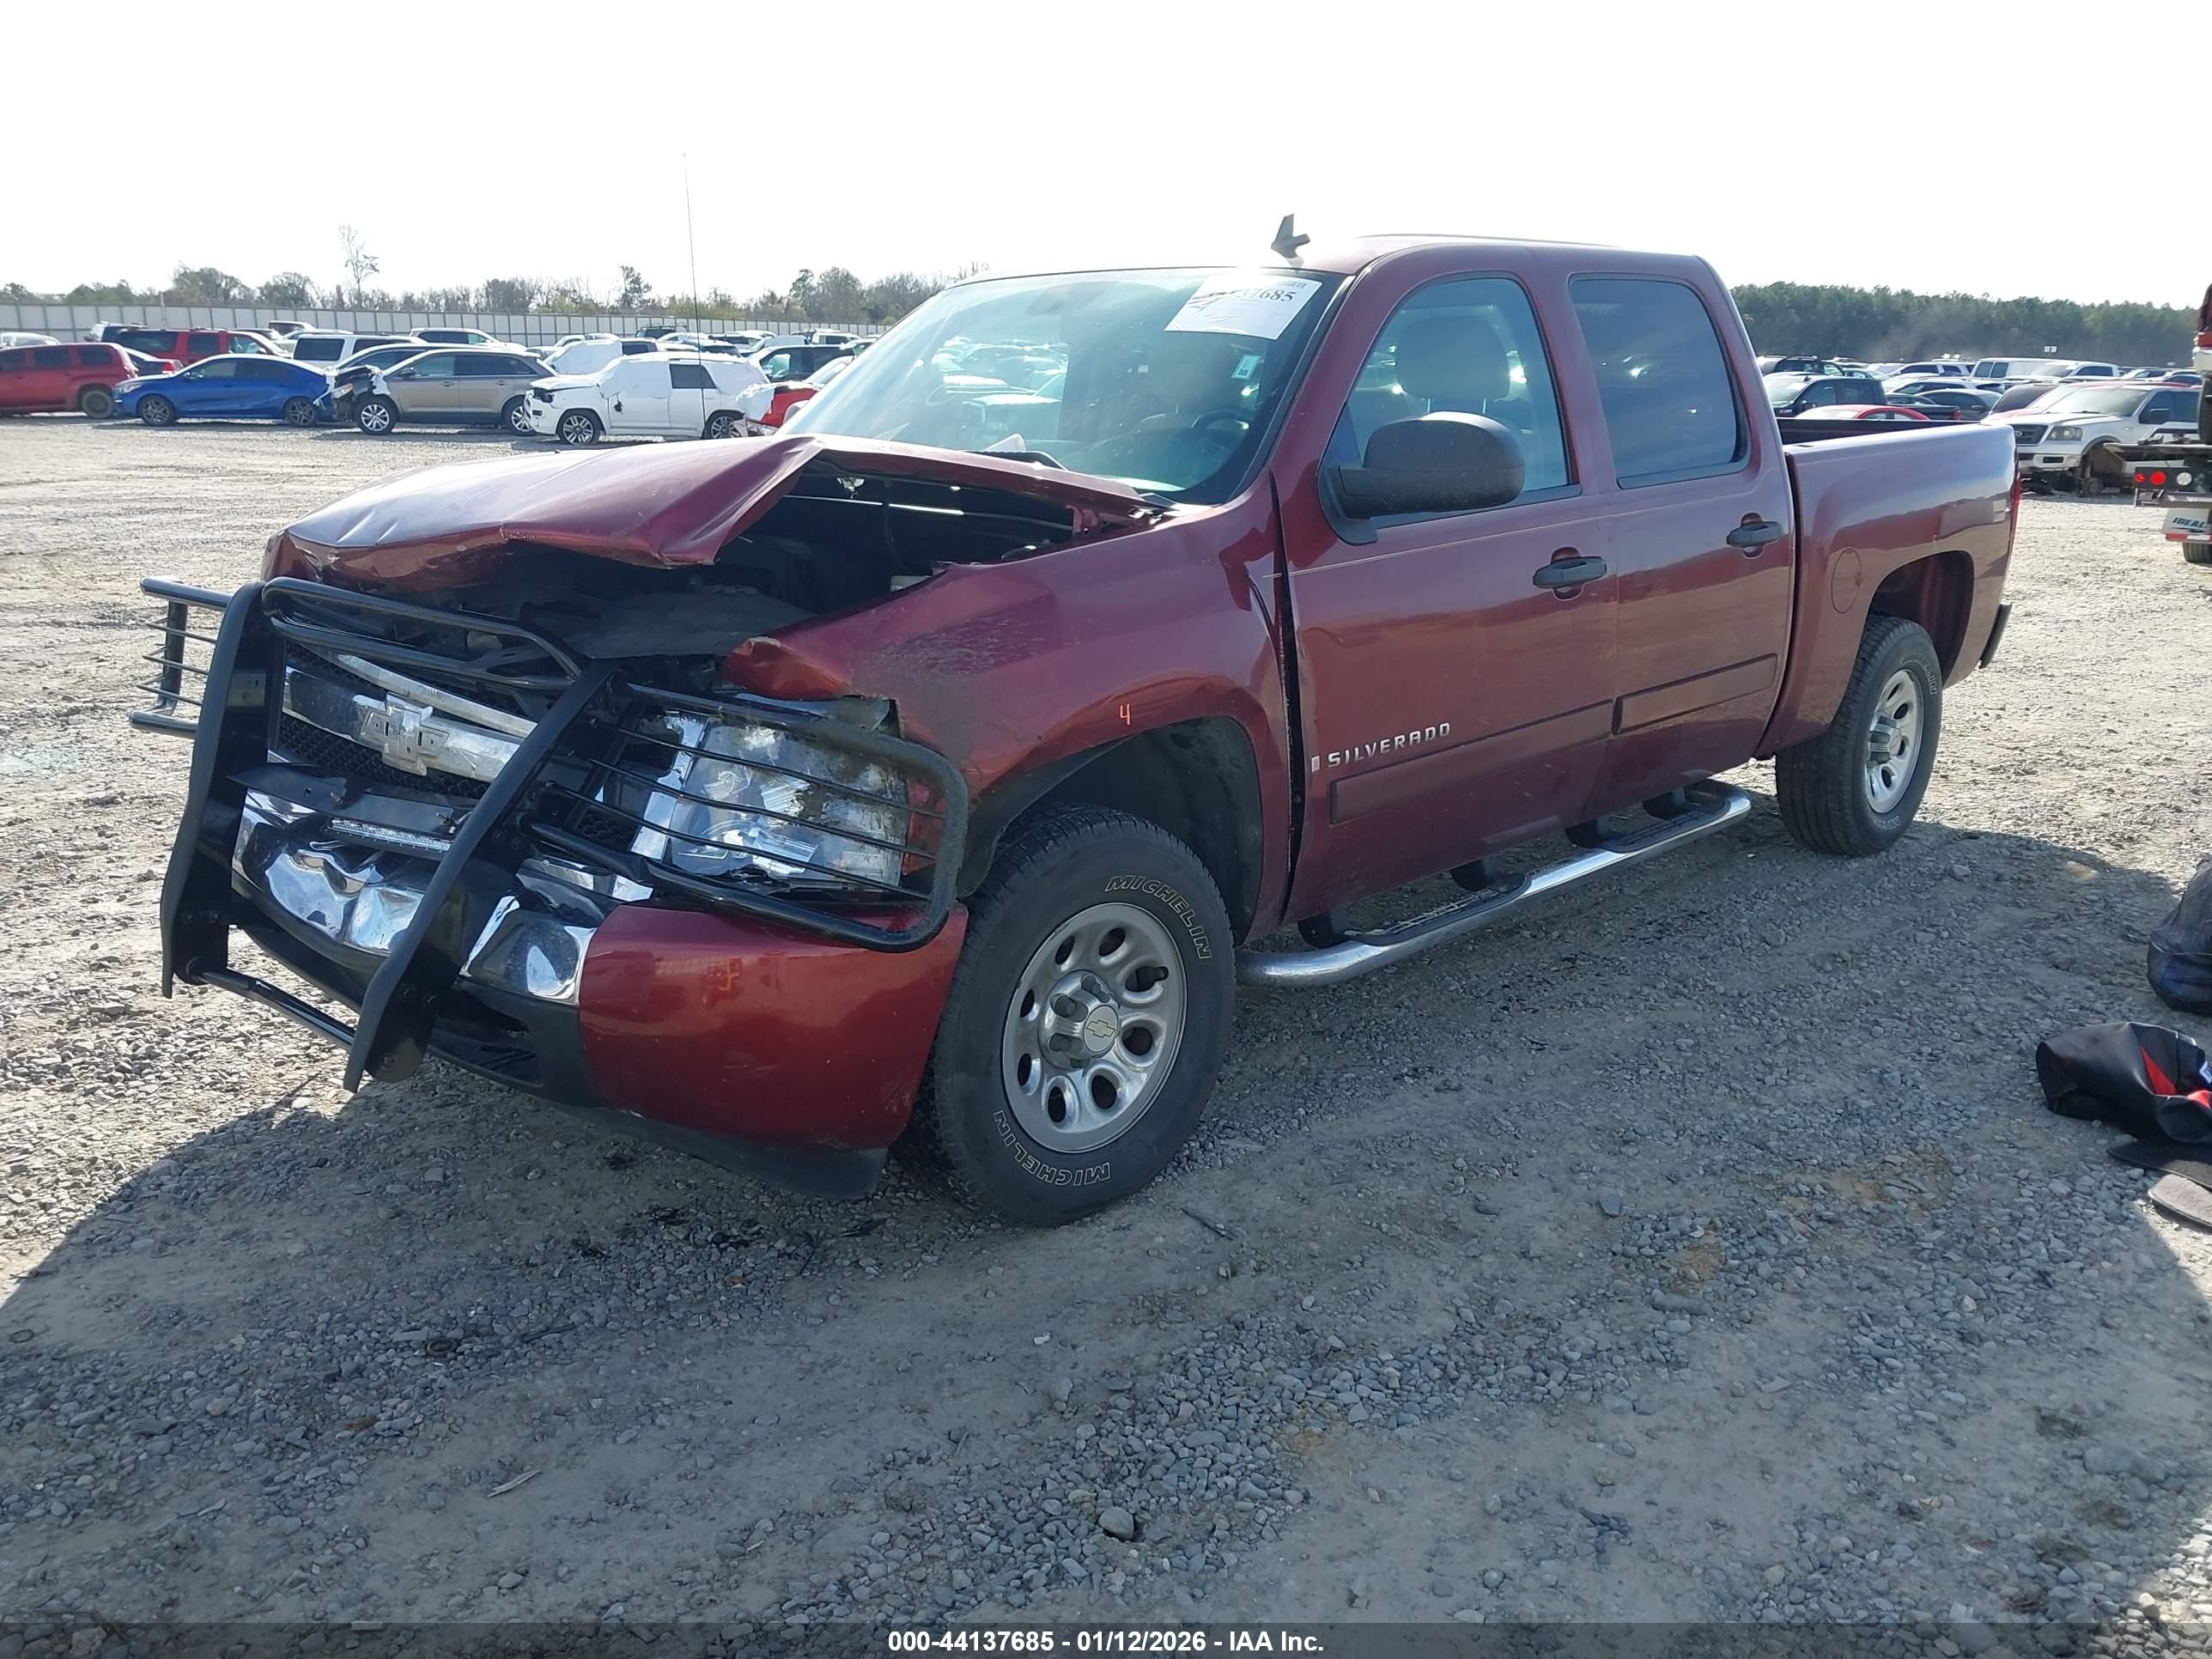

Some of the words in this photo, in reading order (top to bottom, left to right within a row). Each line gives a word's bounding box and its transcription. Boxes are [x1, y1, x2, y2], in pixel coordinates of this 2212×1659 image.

[2172, 517, 2207, 528] IDEAL
[1120, 703, 1131, 726] 4
[1327, 721, 1451, 768] SILVERADO
[1104, 875, 1212, 959] MICHELIN
[993, 1109, 1111, 1187] MICHELIN
